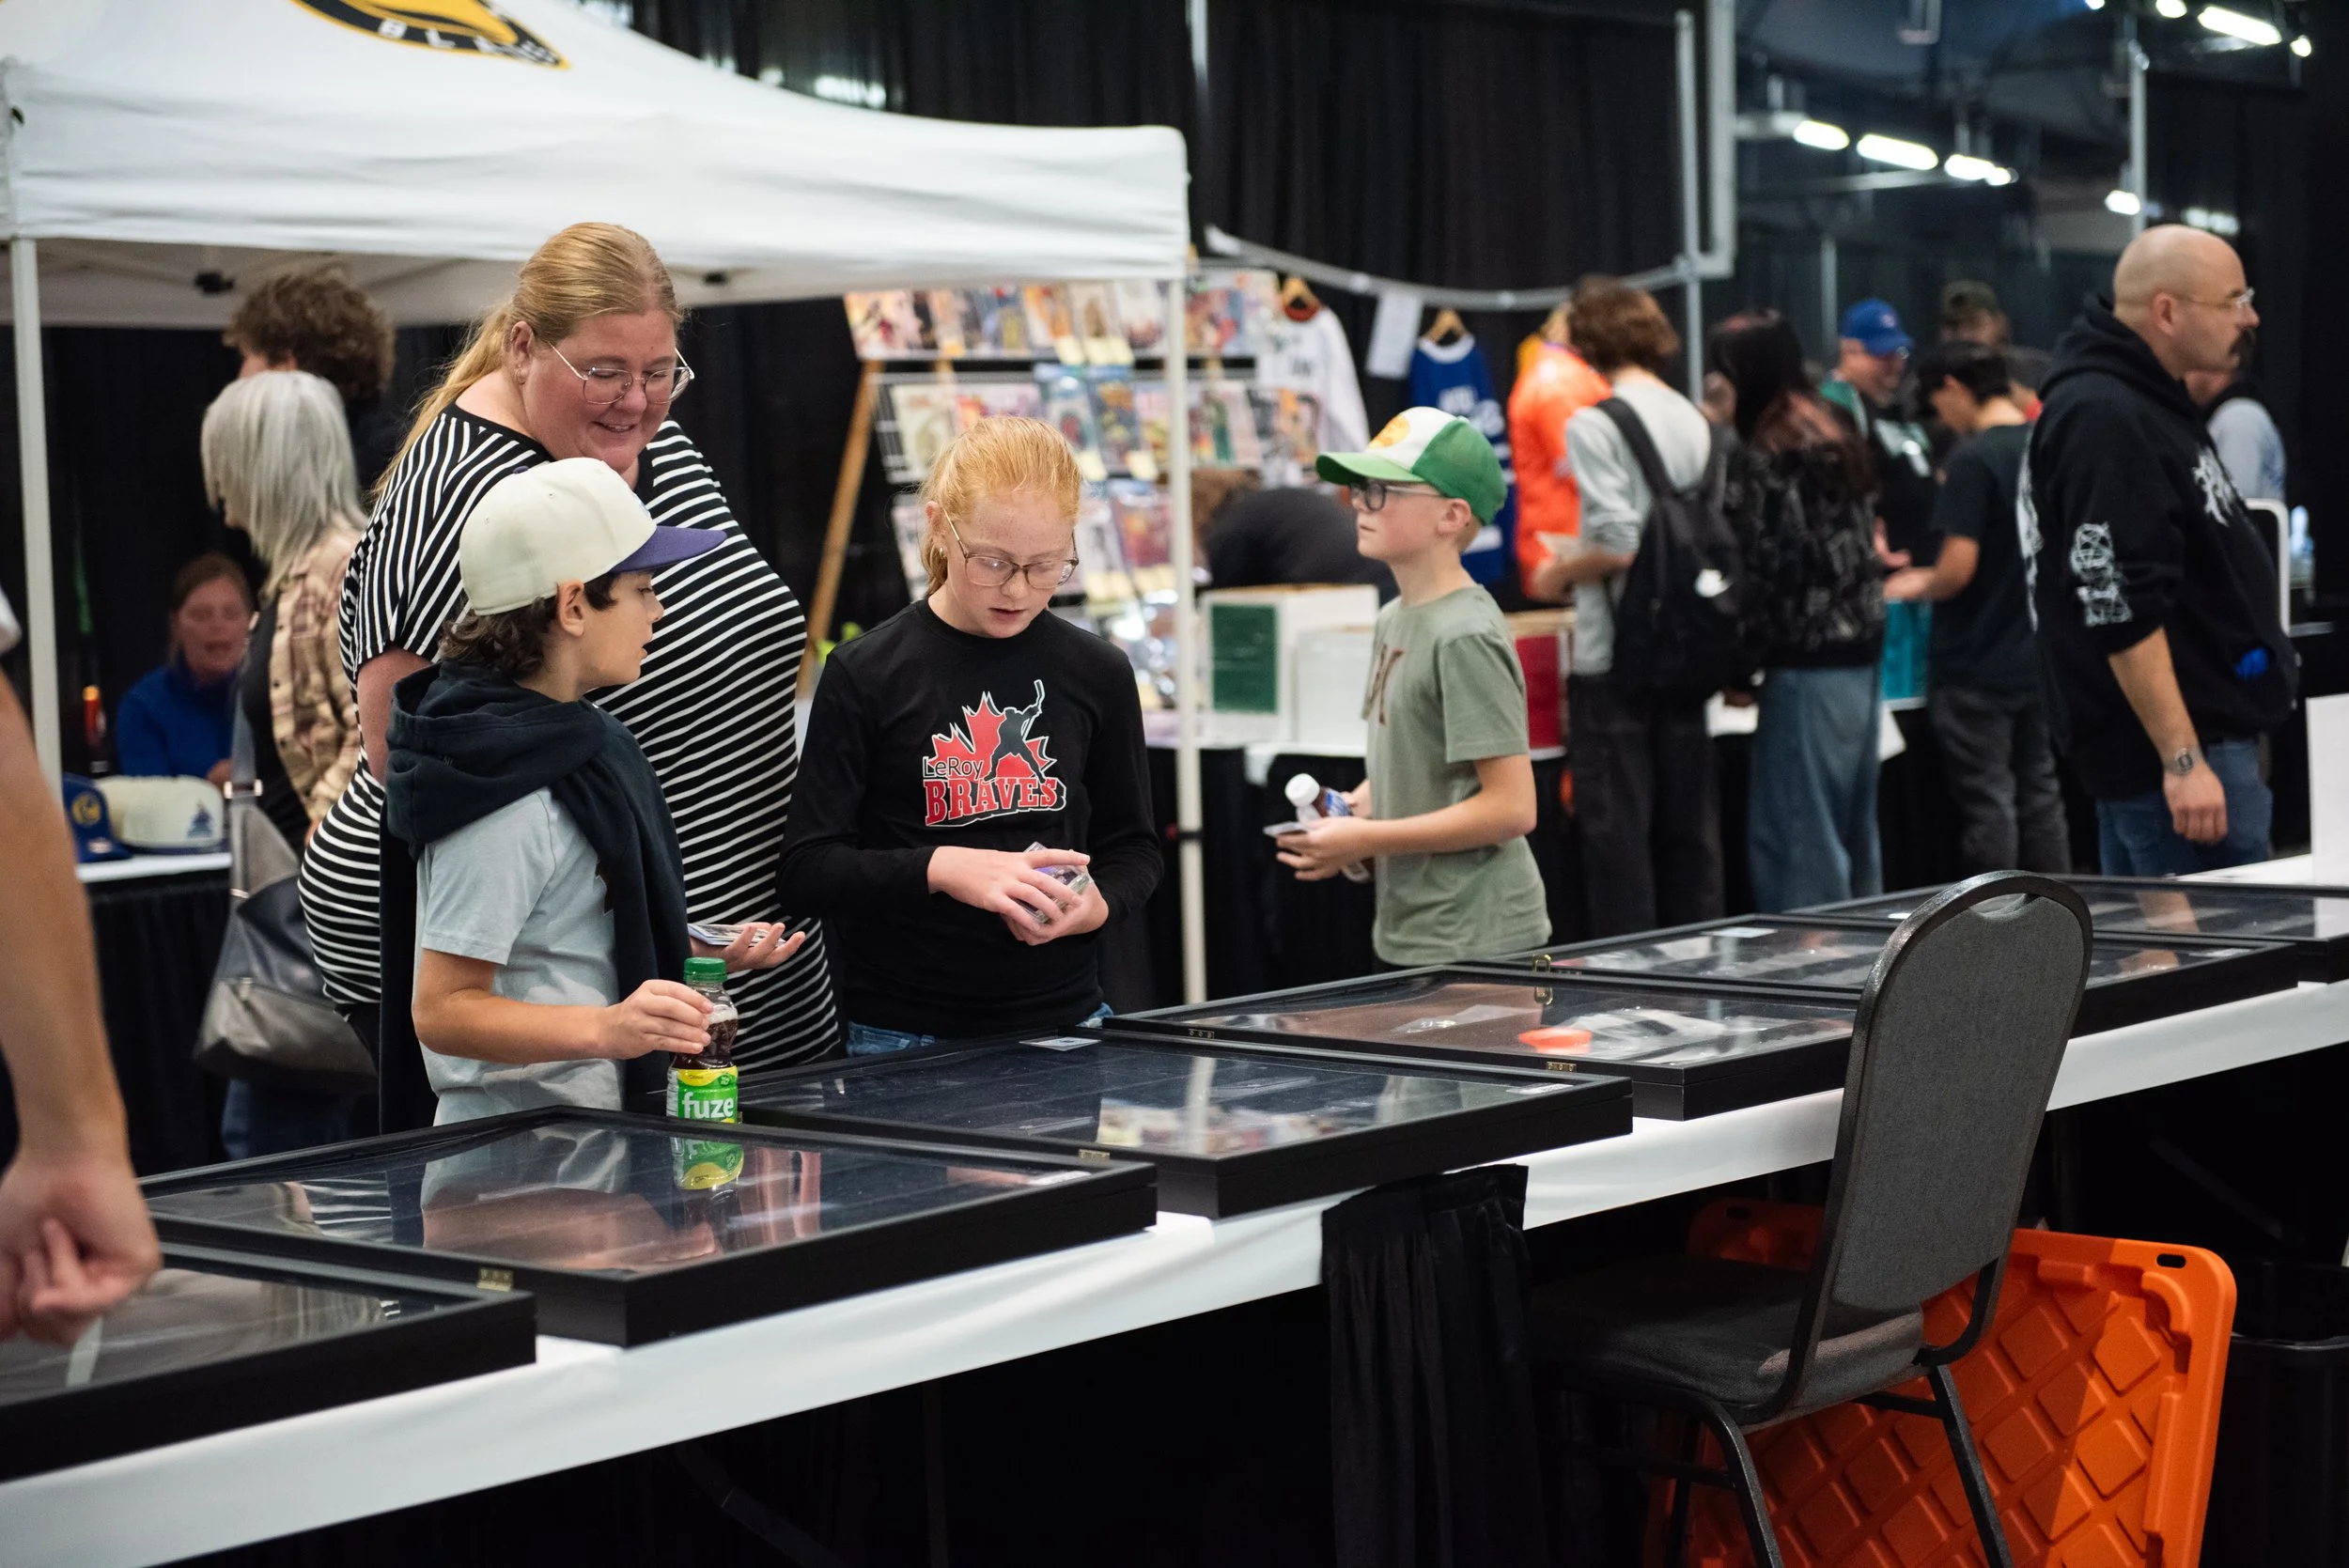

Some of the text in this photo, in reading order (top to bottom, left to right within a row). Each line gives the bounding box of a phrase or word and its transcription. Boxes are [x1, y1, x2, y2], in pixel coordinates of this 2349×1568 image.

[923, 755, 984, 780] LeRoy
[923, 777, 1058, 827] BRAVES
[682, 1091, 734, 1119] fuze
